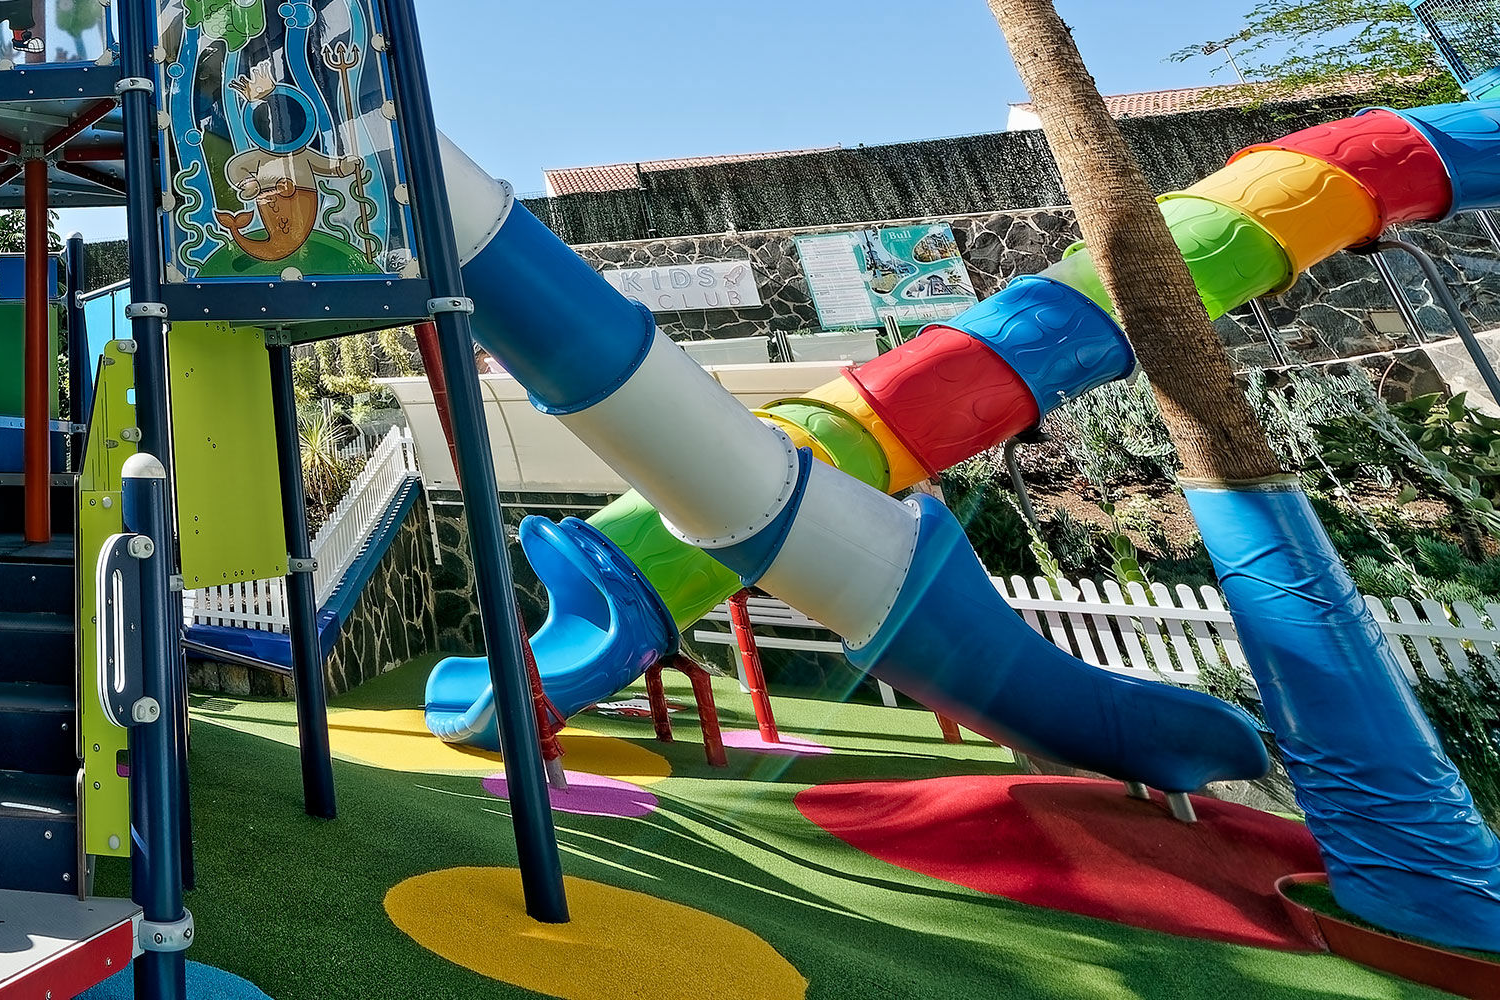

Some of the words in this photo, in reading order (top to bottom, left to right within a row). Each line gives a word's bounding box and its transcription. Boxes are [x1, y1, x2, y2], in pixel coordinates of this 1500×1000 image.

[888, 230, 912, 240] Bull
[620, 265, 717, 292] KIDS
[657, 290, 742, 310] CLUB
